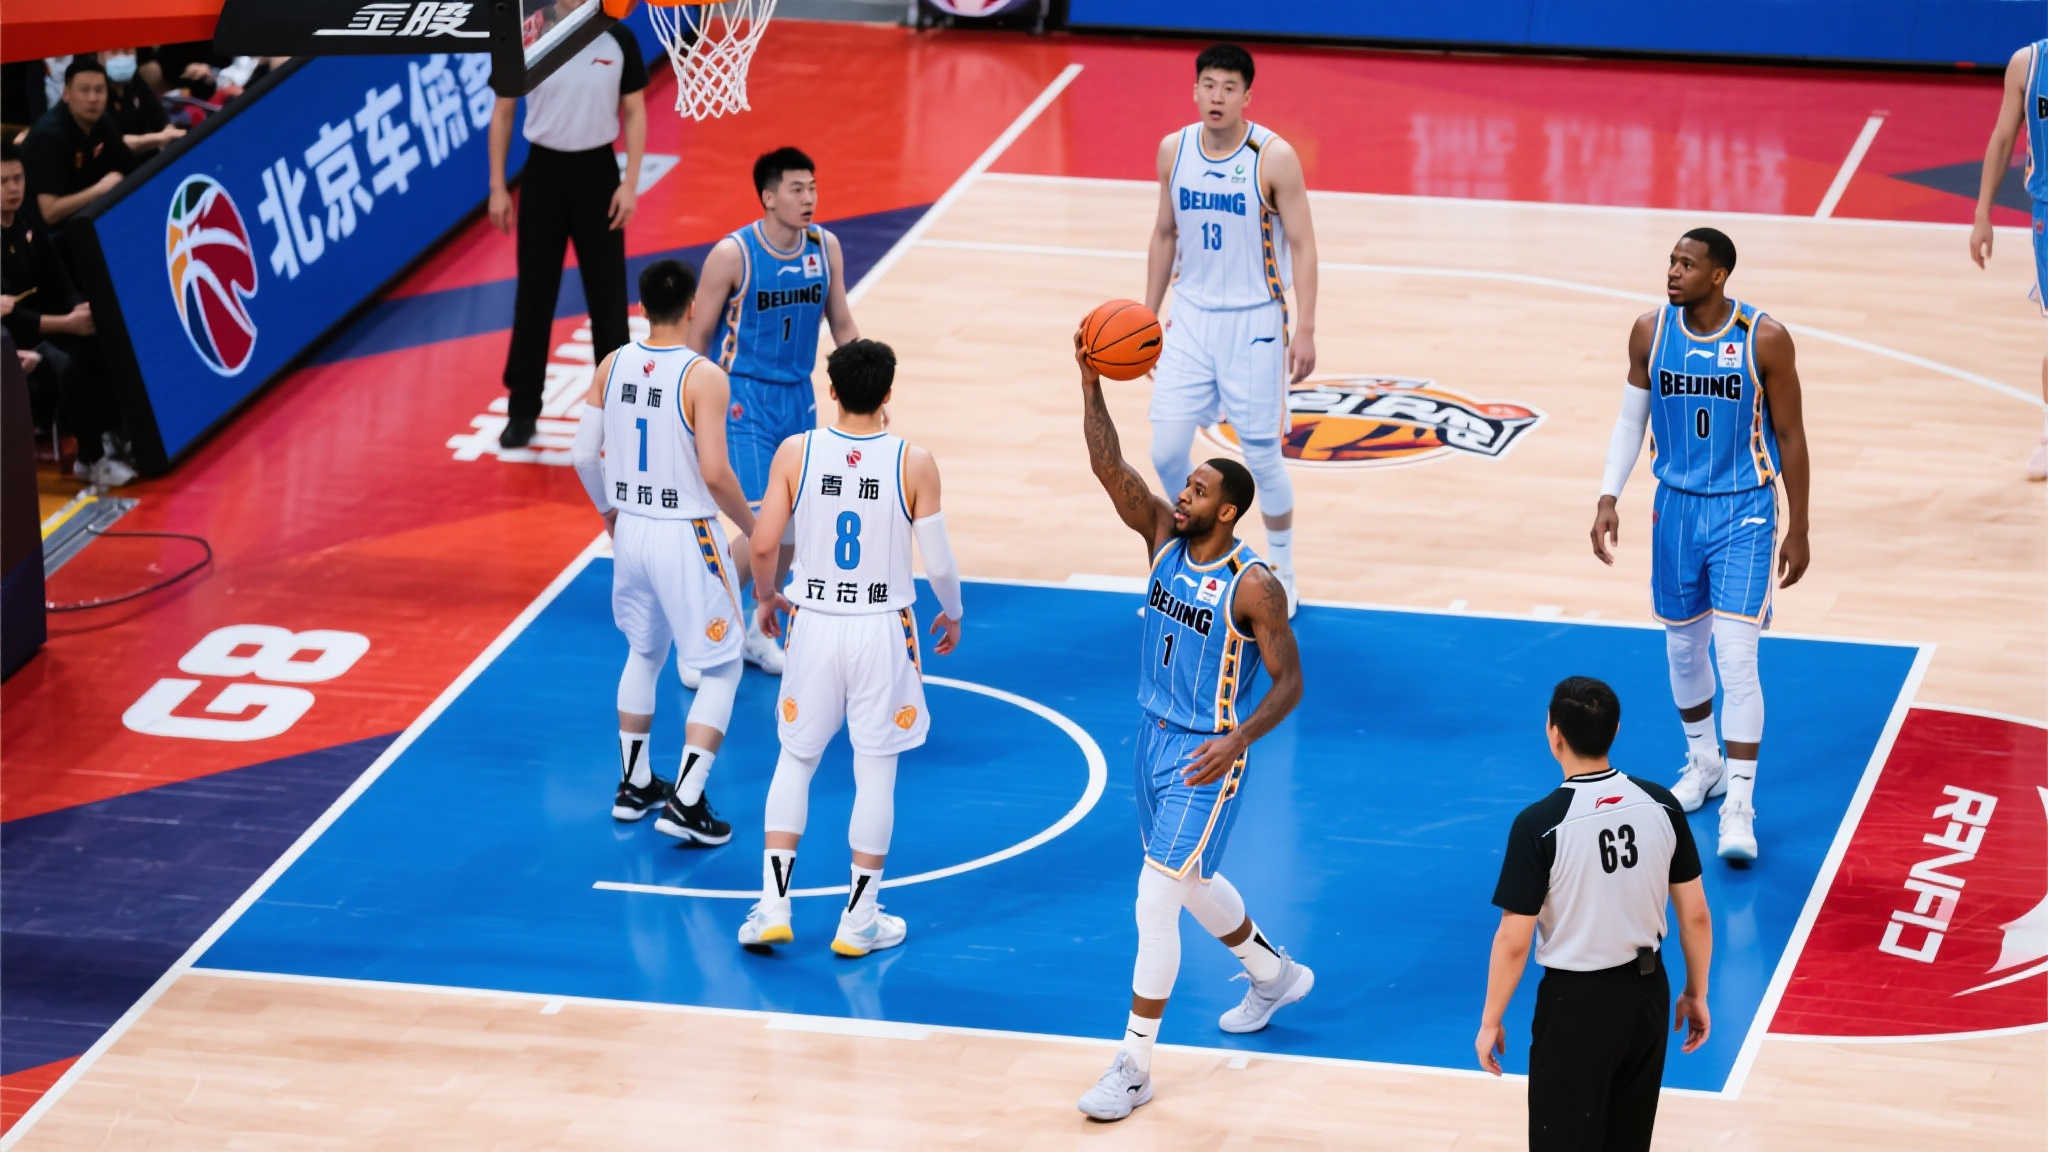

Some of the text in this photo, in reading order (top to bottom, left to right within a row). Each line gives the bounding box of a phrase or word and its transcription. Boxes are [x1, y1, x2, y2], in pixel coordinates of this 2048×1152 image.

[1201, 221, 1222, 250] 13
[783, 316, 792, 342] 1
[1696, 407, 1710, 440] 0
[636, 418, 648, 472] 1
[835, 510, 862, 570] 8
[1149, 578, 1214, 637] BEIJING
[1163, 633, 1174, 668] 1
[1598, 824, 1639, 874] 63
